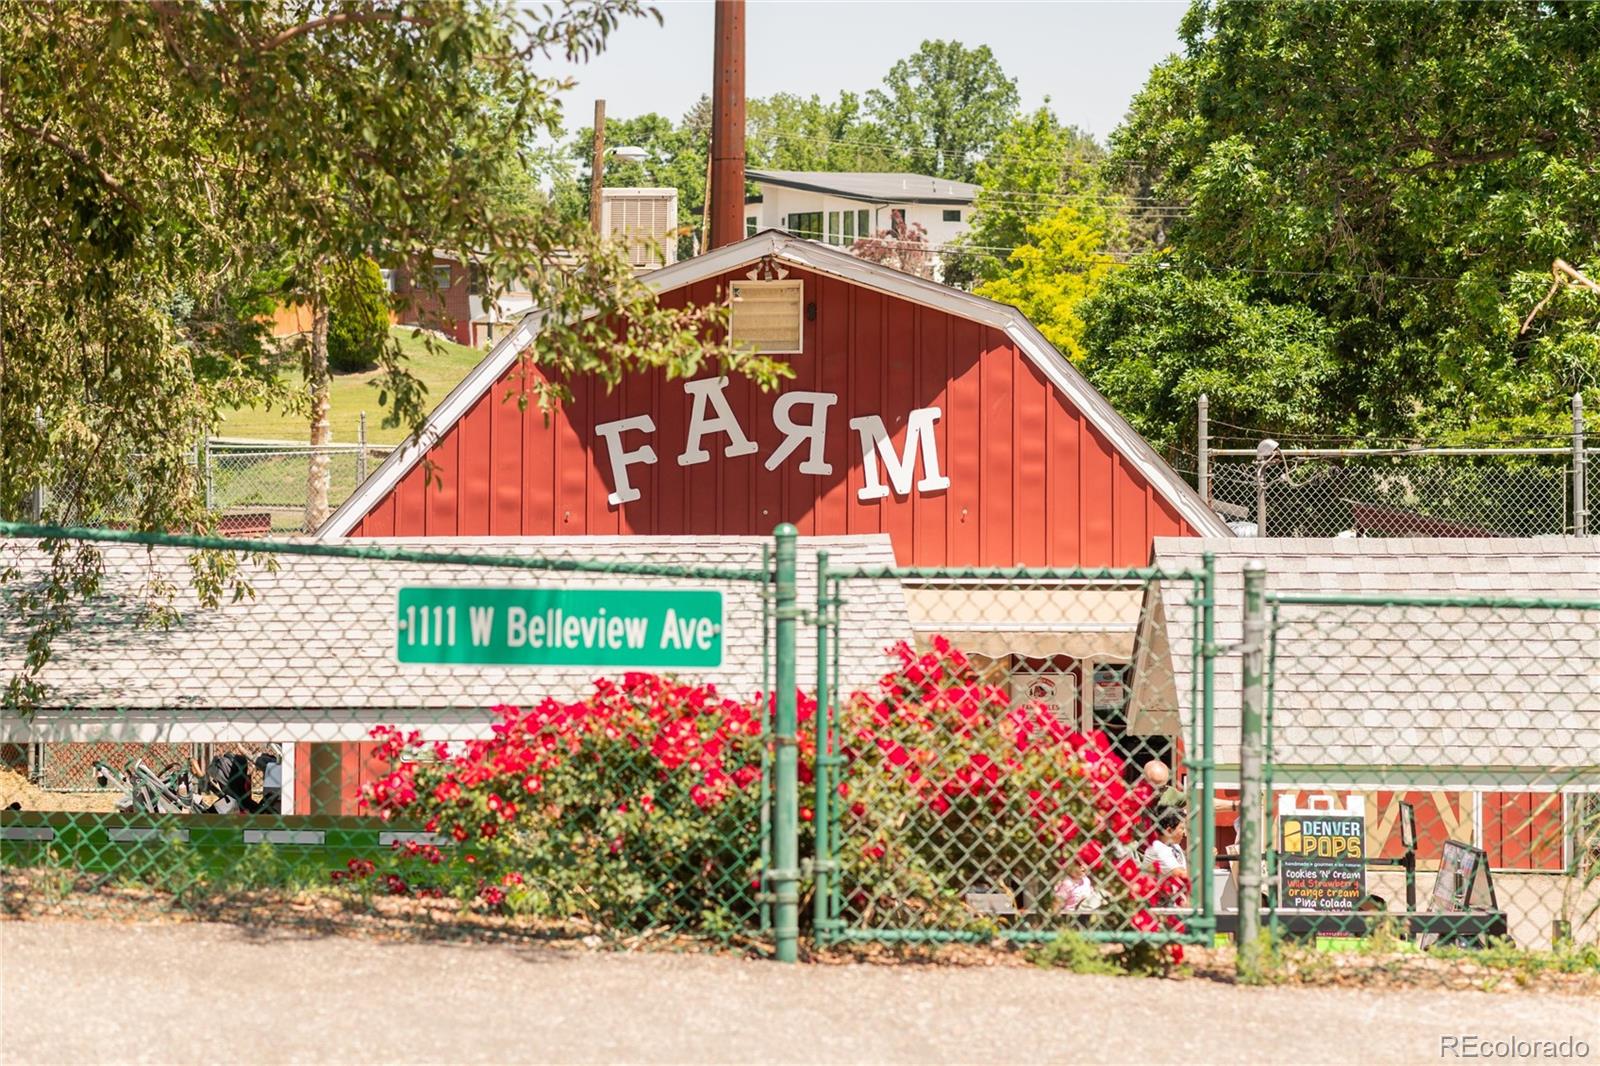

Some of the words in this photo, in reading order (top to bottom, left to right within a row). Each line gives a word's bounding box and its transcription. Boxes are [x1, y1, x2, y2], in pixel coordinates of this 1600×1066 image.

[595, 376, 951, 505] FARM
[406, 605, 456, 646] 1111
[469, 606, 494, 647] W
[507, 606, 648, 649] Belleview
[660, 608, 713, 650] Ave
[1303, 821, 1361, 836] DENVER
[1303, 836, 1361, 858] POPS
[1286, 869, 1318, 879] Cookies
